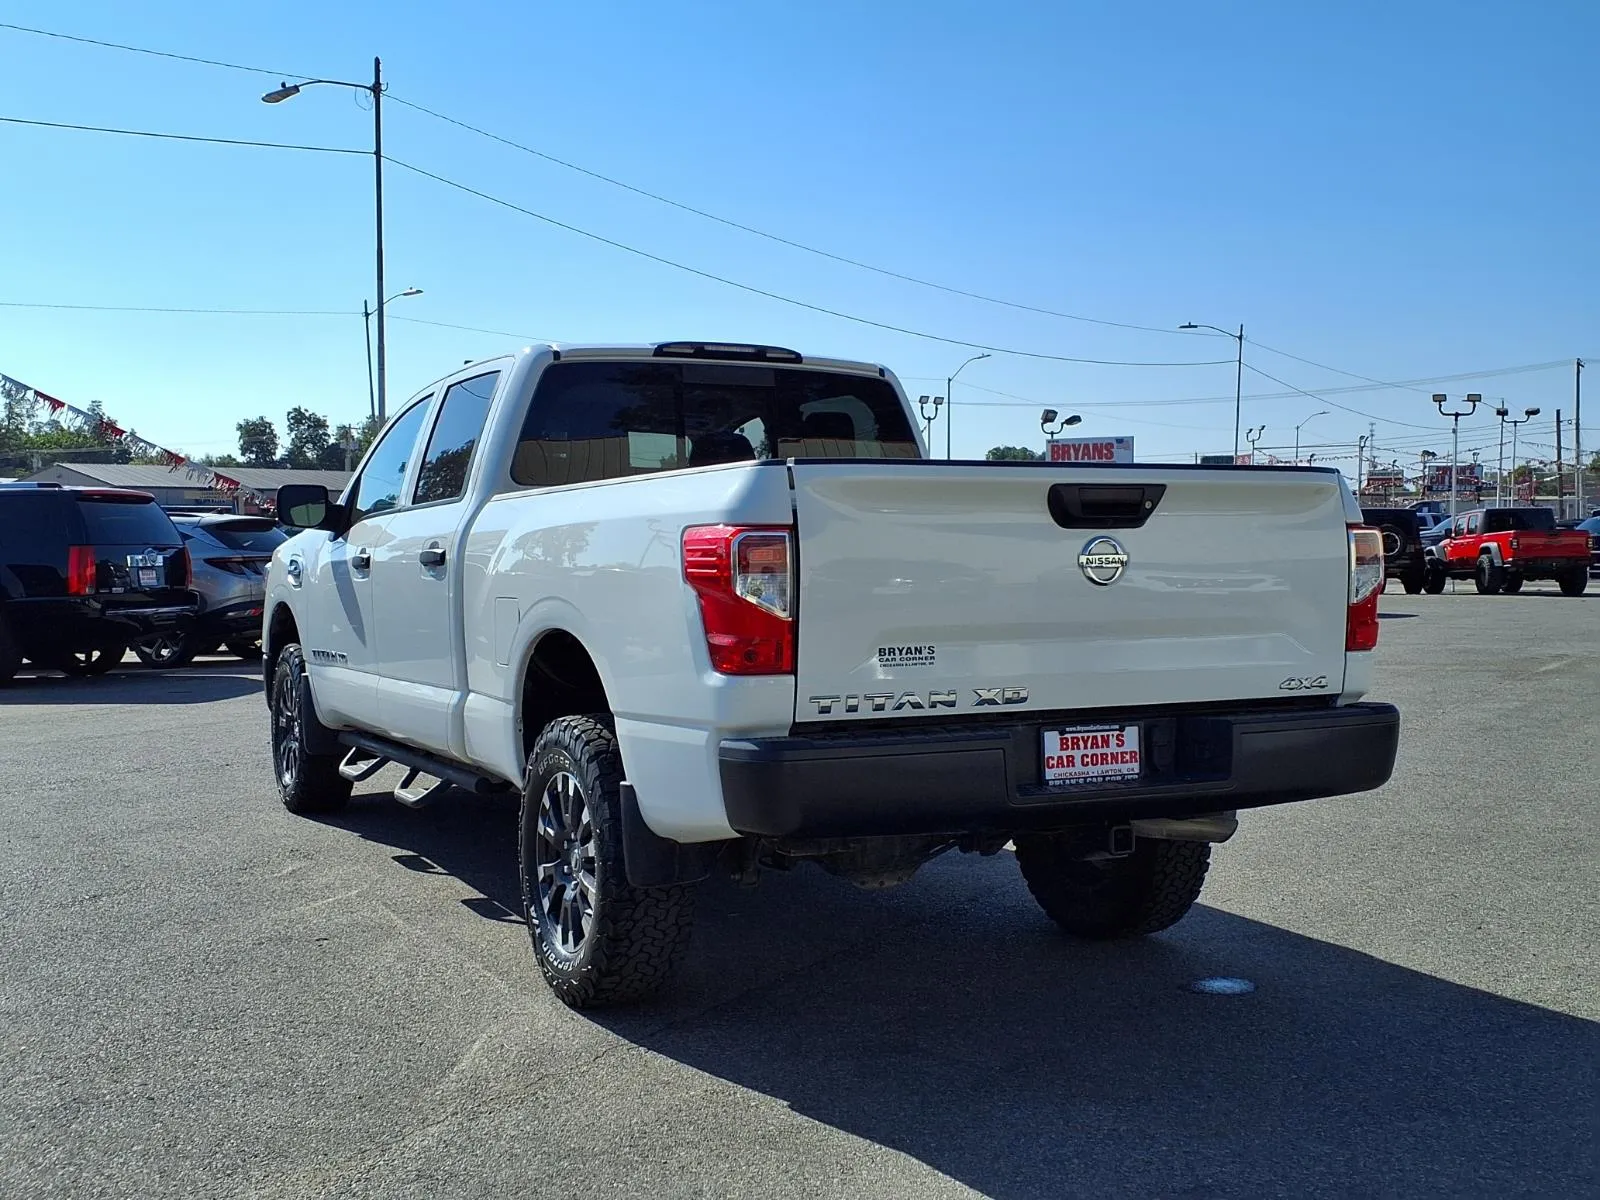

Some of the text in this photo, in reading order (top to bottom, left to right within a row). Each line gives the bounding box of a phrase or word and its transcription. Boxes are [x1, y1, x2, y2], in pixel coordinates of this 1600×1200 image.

[1051, 442, 1114, 461] BRYANS
[1086, 557, 1124, 565] NISSAN
[878, 646, 935, 656] BRYAN'S
[809, 687, 1029, 715] TITAN XD
[1059, 733, 1125, 751] BRYAN'S
[1046, 750, 1138, 769] CAR CORNER
[1053, 770, 1090, 778] CHICKASHA
